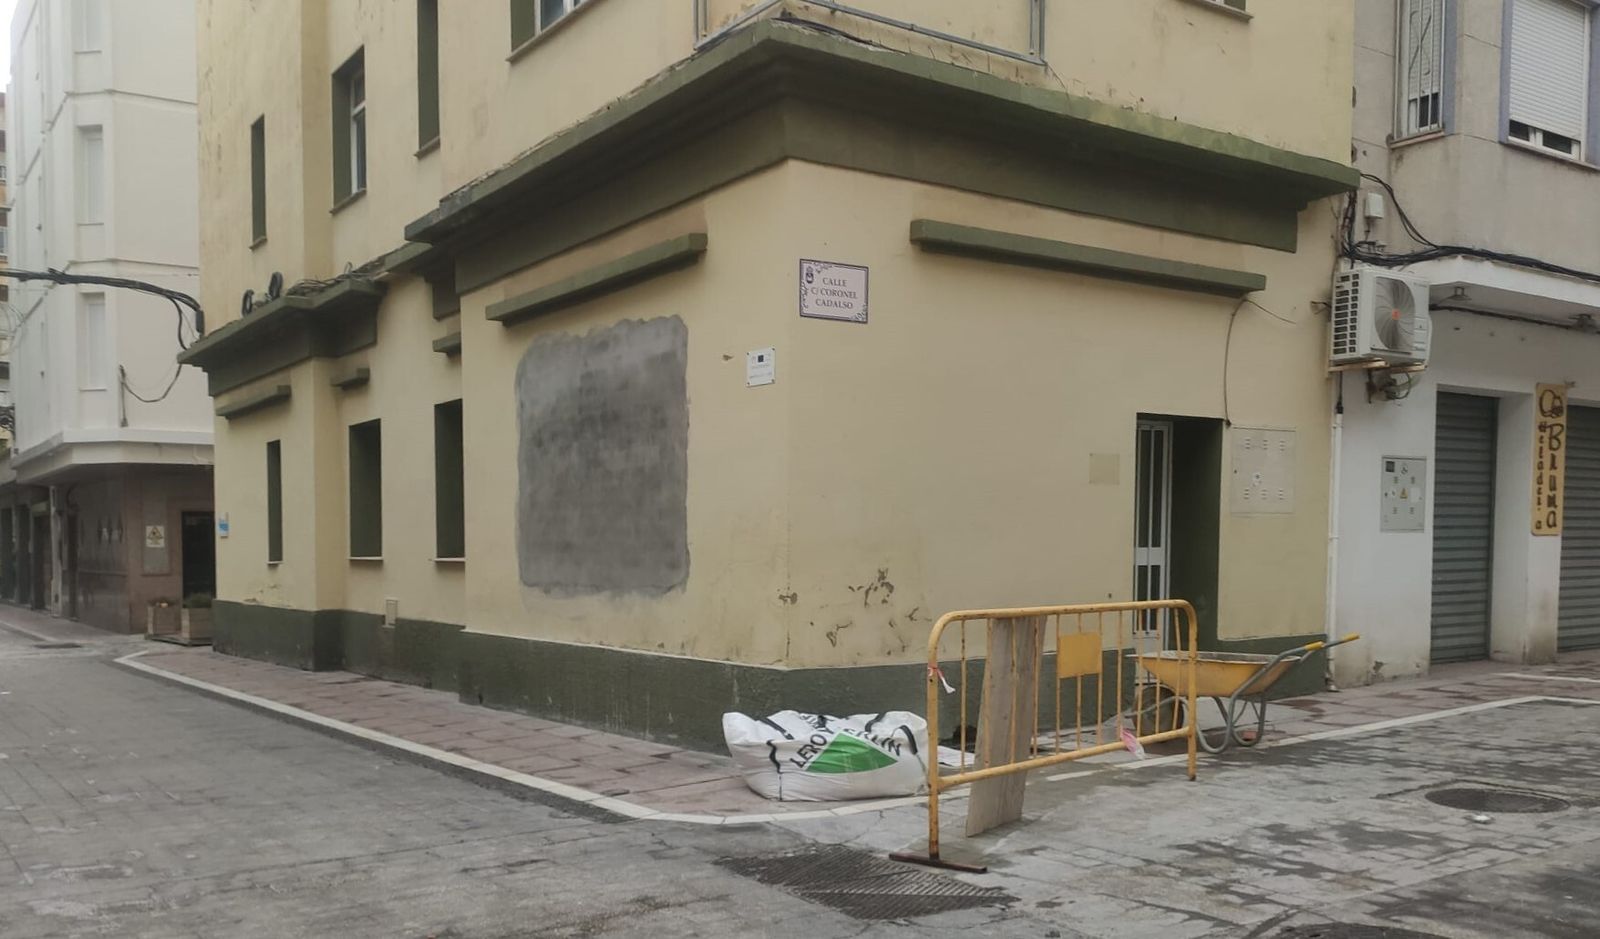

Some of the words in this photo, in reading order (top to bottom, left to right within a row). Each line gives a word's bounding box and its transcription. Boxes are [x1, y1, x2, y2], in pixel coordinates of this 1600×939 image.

[822, 277, 848, 287] CALLE
[820, 287, 858, 299] CORONEL
[815, 298, 854, 309] CADALSO
[789, 726, 834, 768] LEROY
